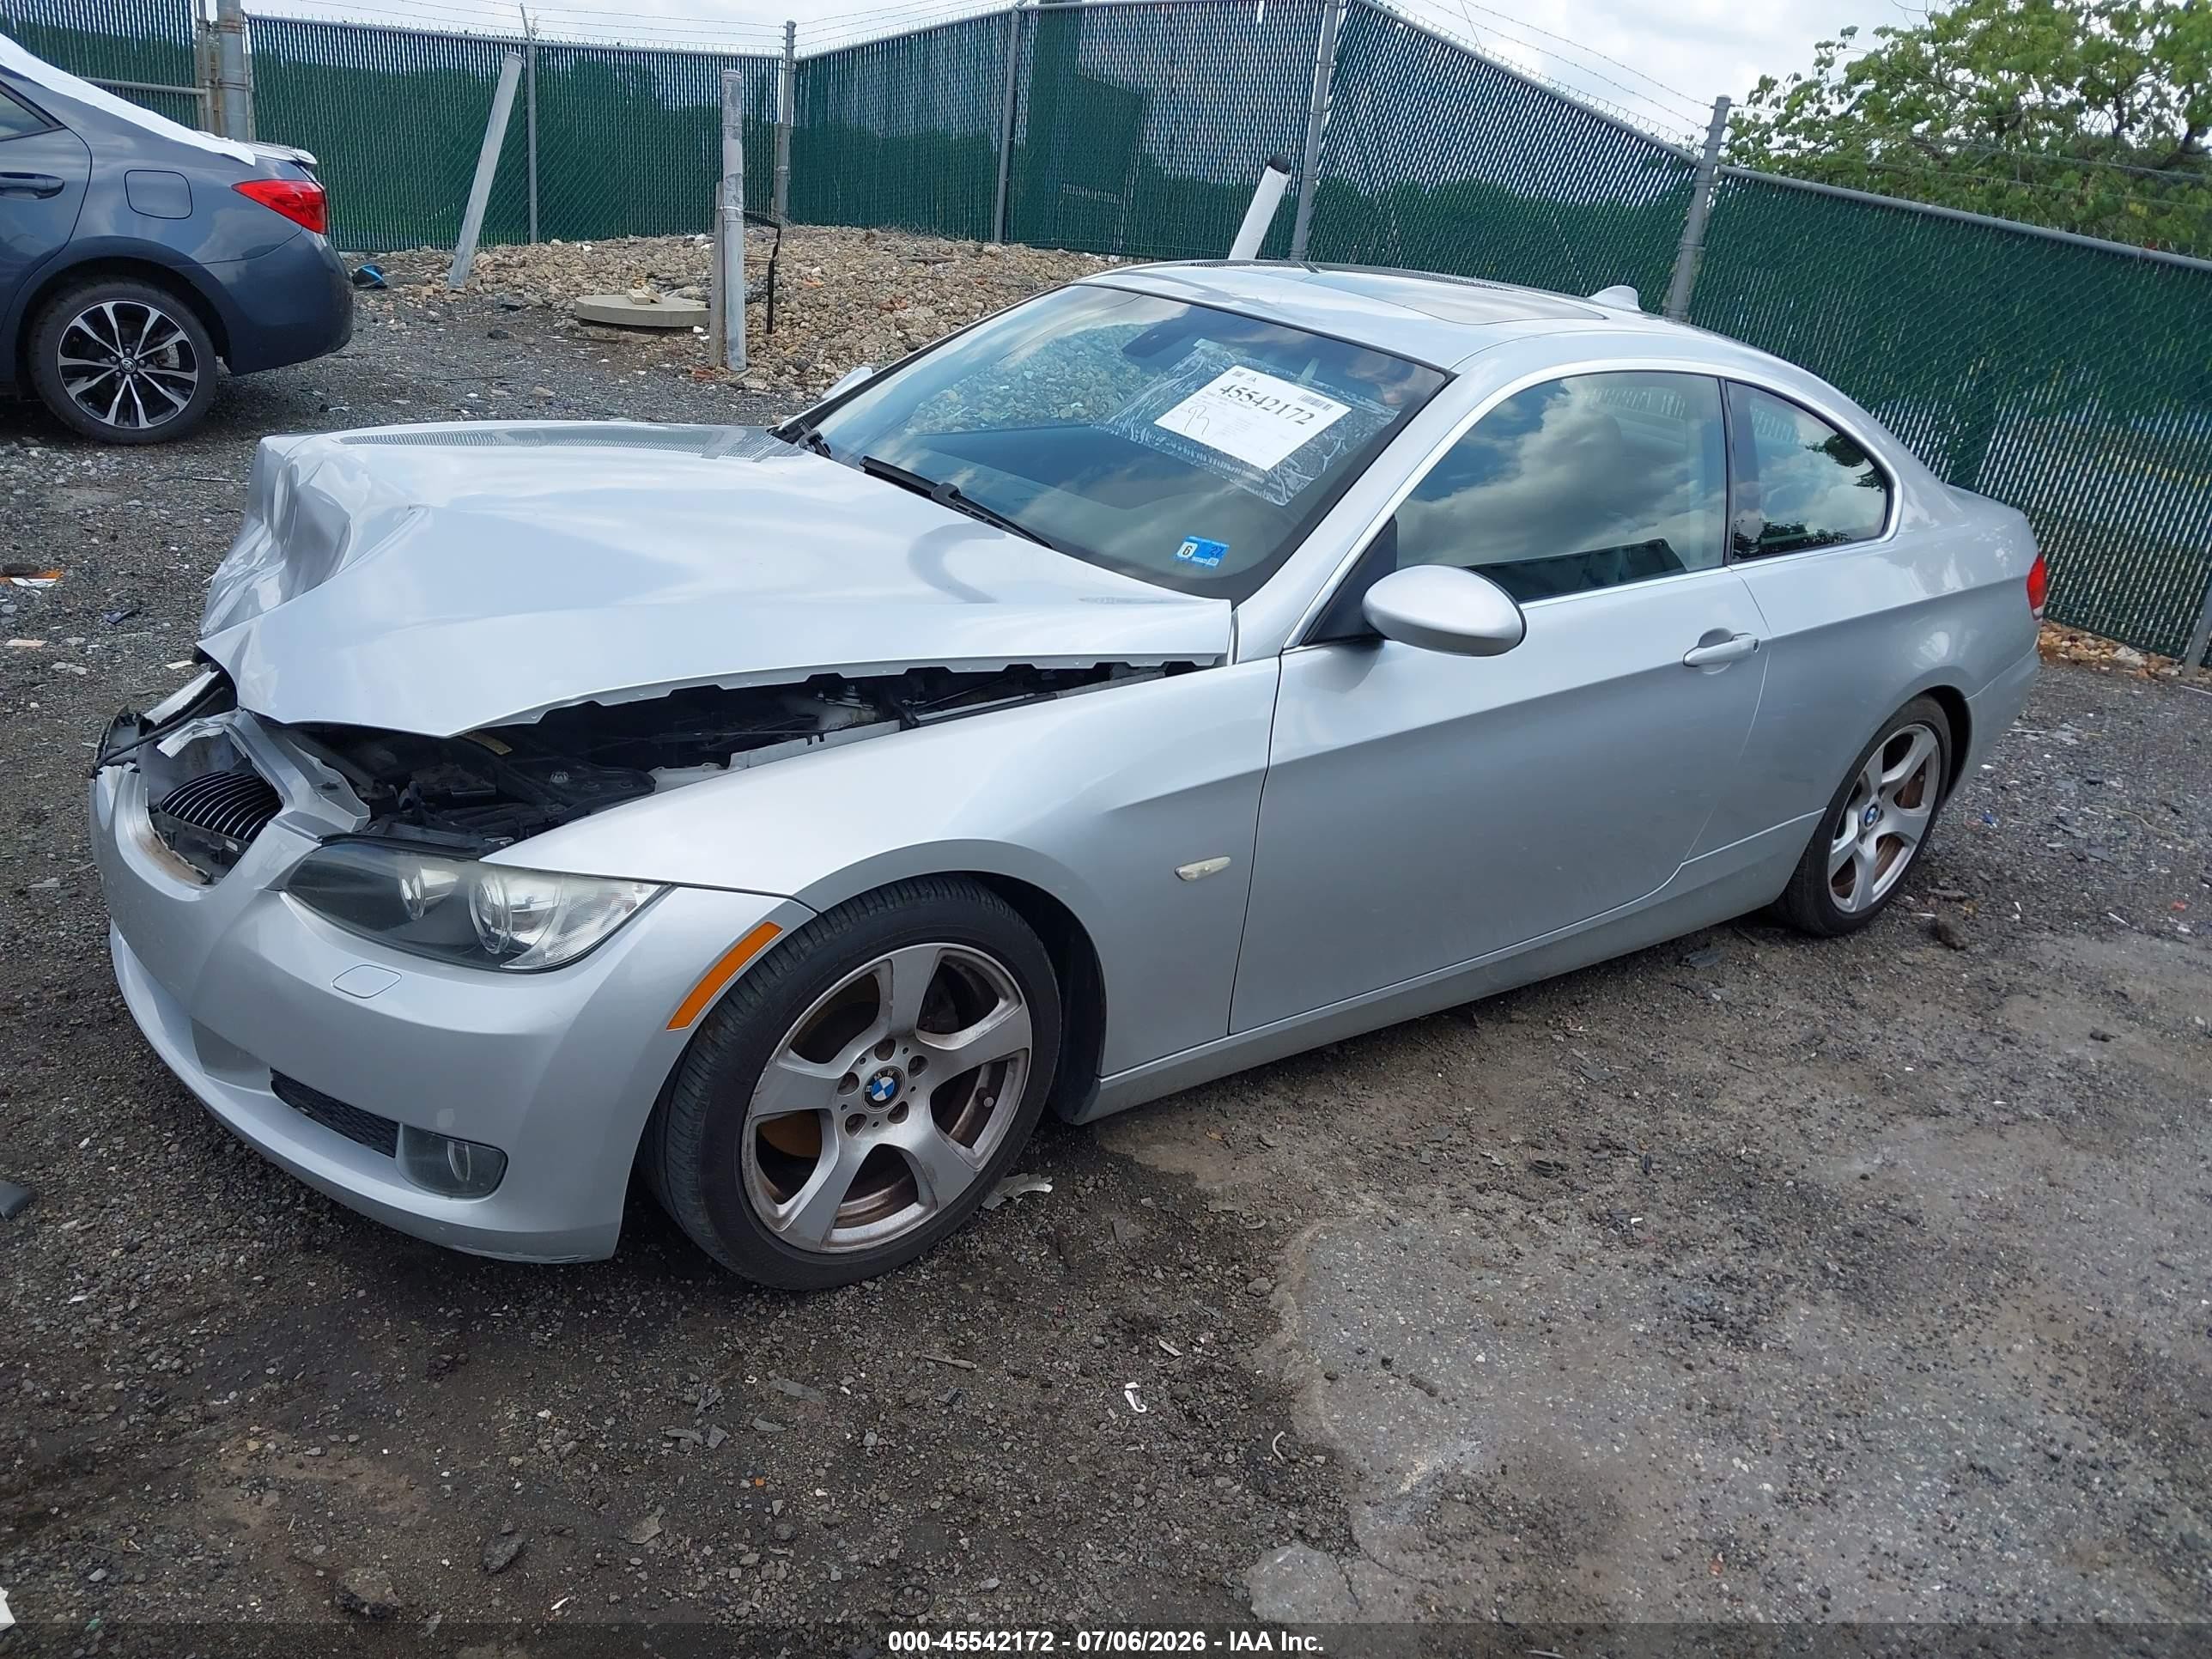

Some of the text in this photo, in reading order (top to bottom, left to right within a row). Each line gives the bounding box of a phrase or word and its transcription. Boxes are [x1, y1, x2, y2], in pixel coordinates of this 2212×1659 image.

[1219, 384, 1316, 426] 45542172
[1182, 545, 1225, 558] 6 27
